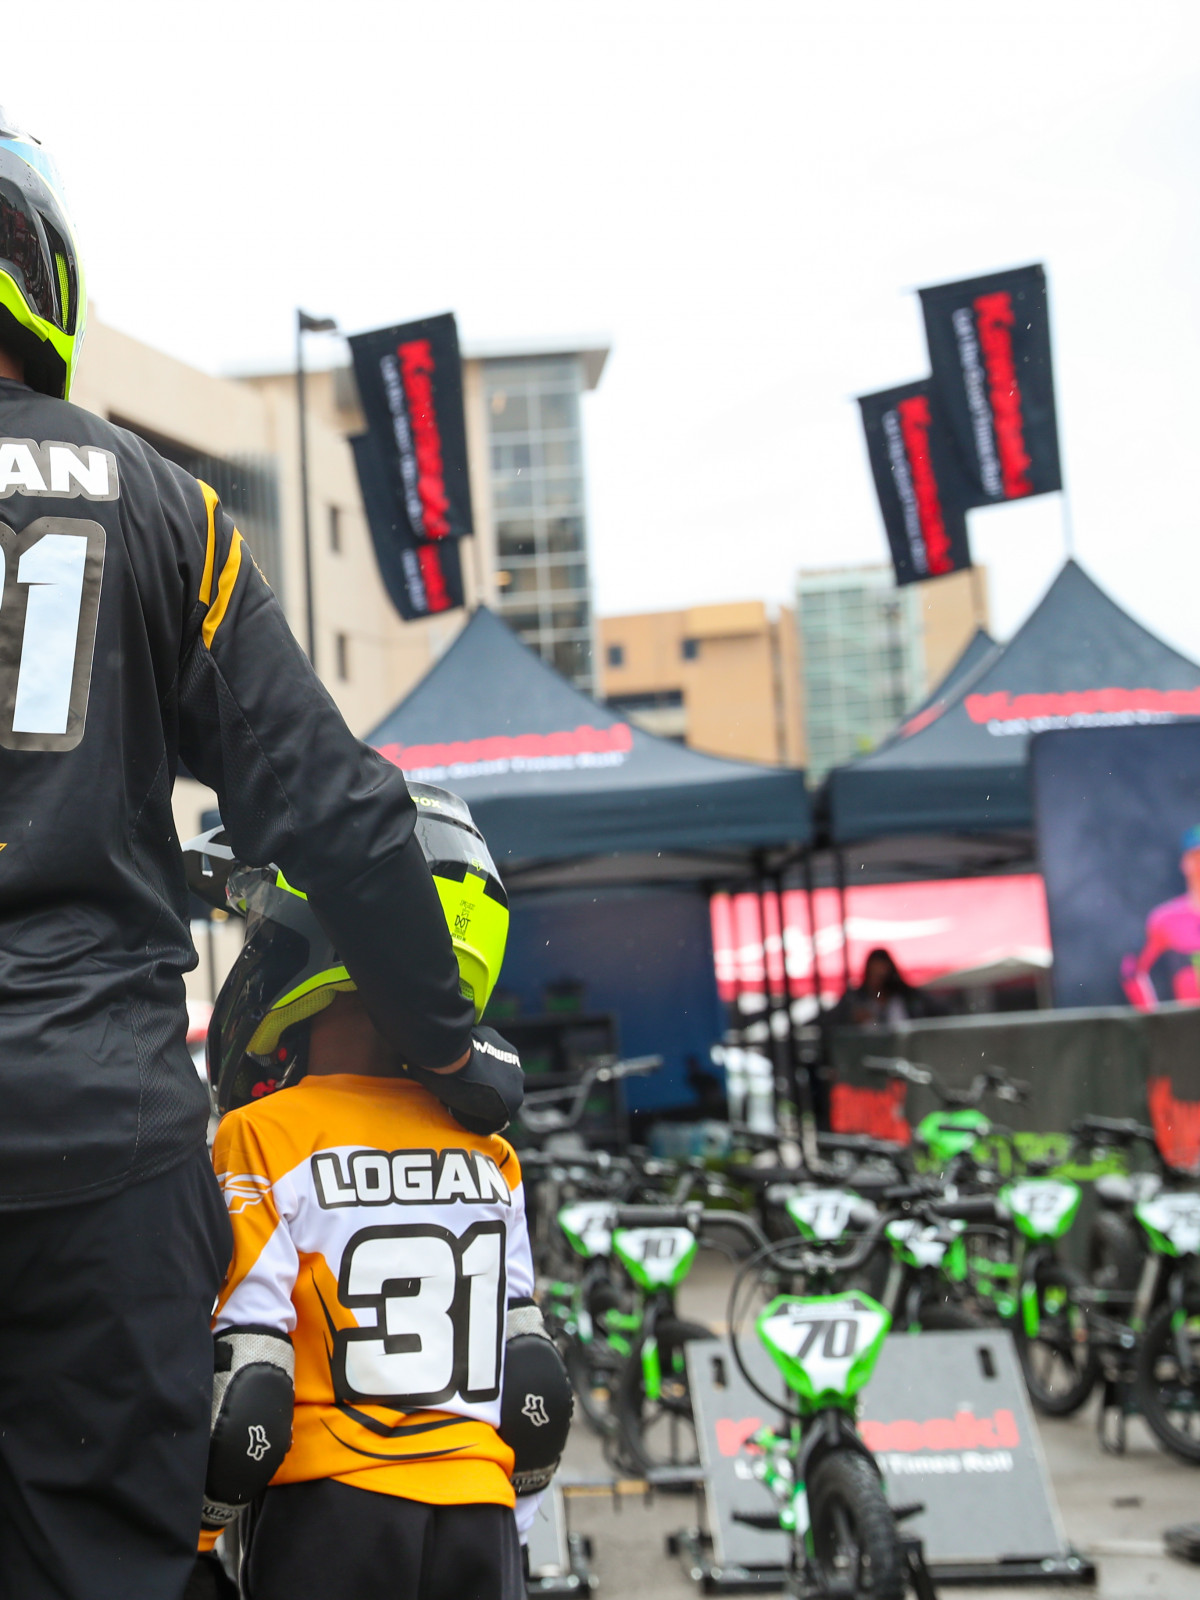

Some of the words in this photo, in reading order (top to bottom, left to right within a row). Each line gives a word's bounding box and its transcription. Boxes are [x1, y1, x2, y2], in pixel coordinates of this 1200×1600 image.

[314, 1151, 511, 1207] LOGAN
[340, 1227, 504, 1400] 31
[793, 1319, 858, 1360] 70
